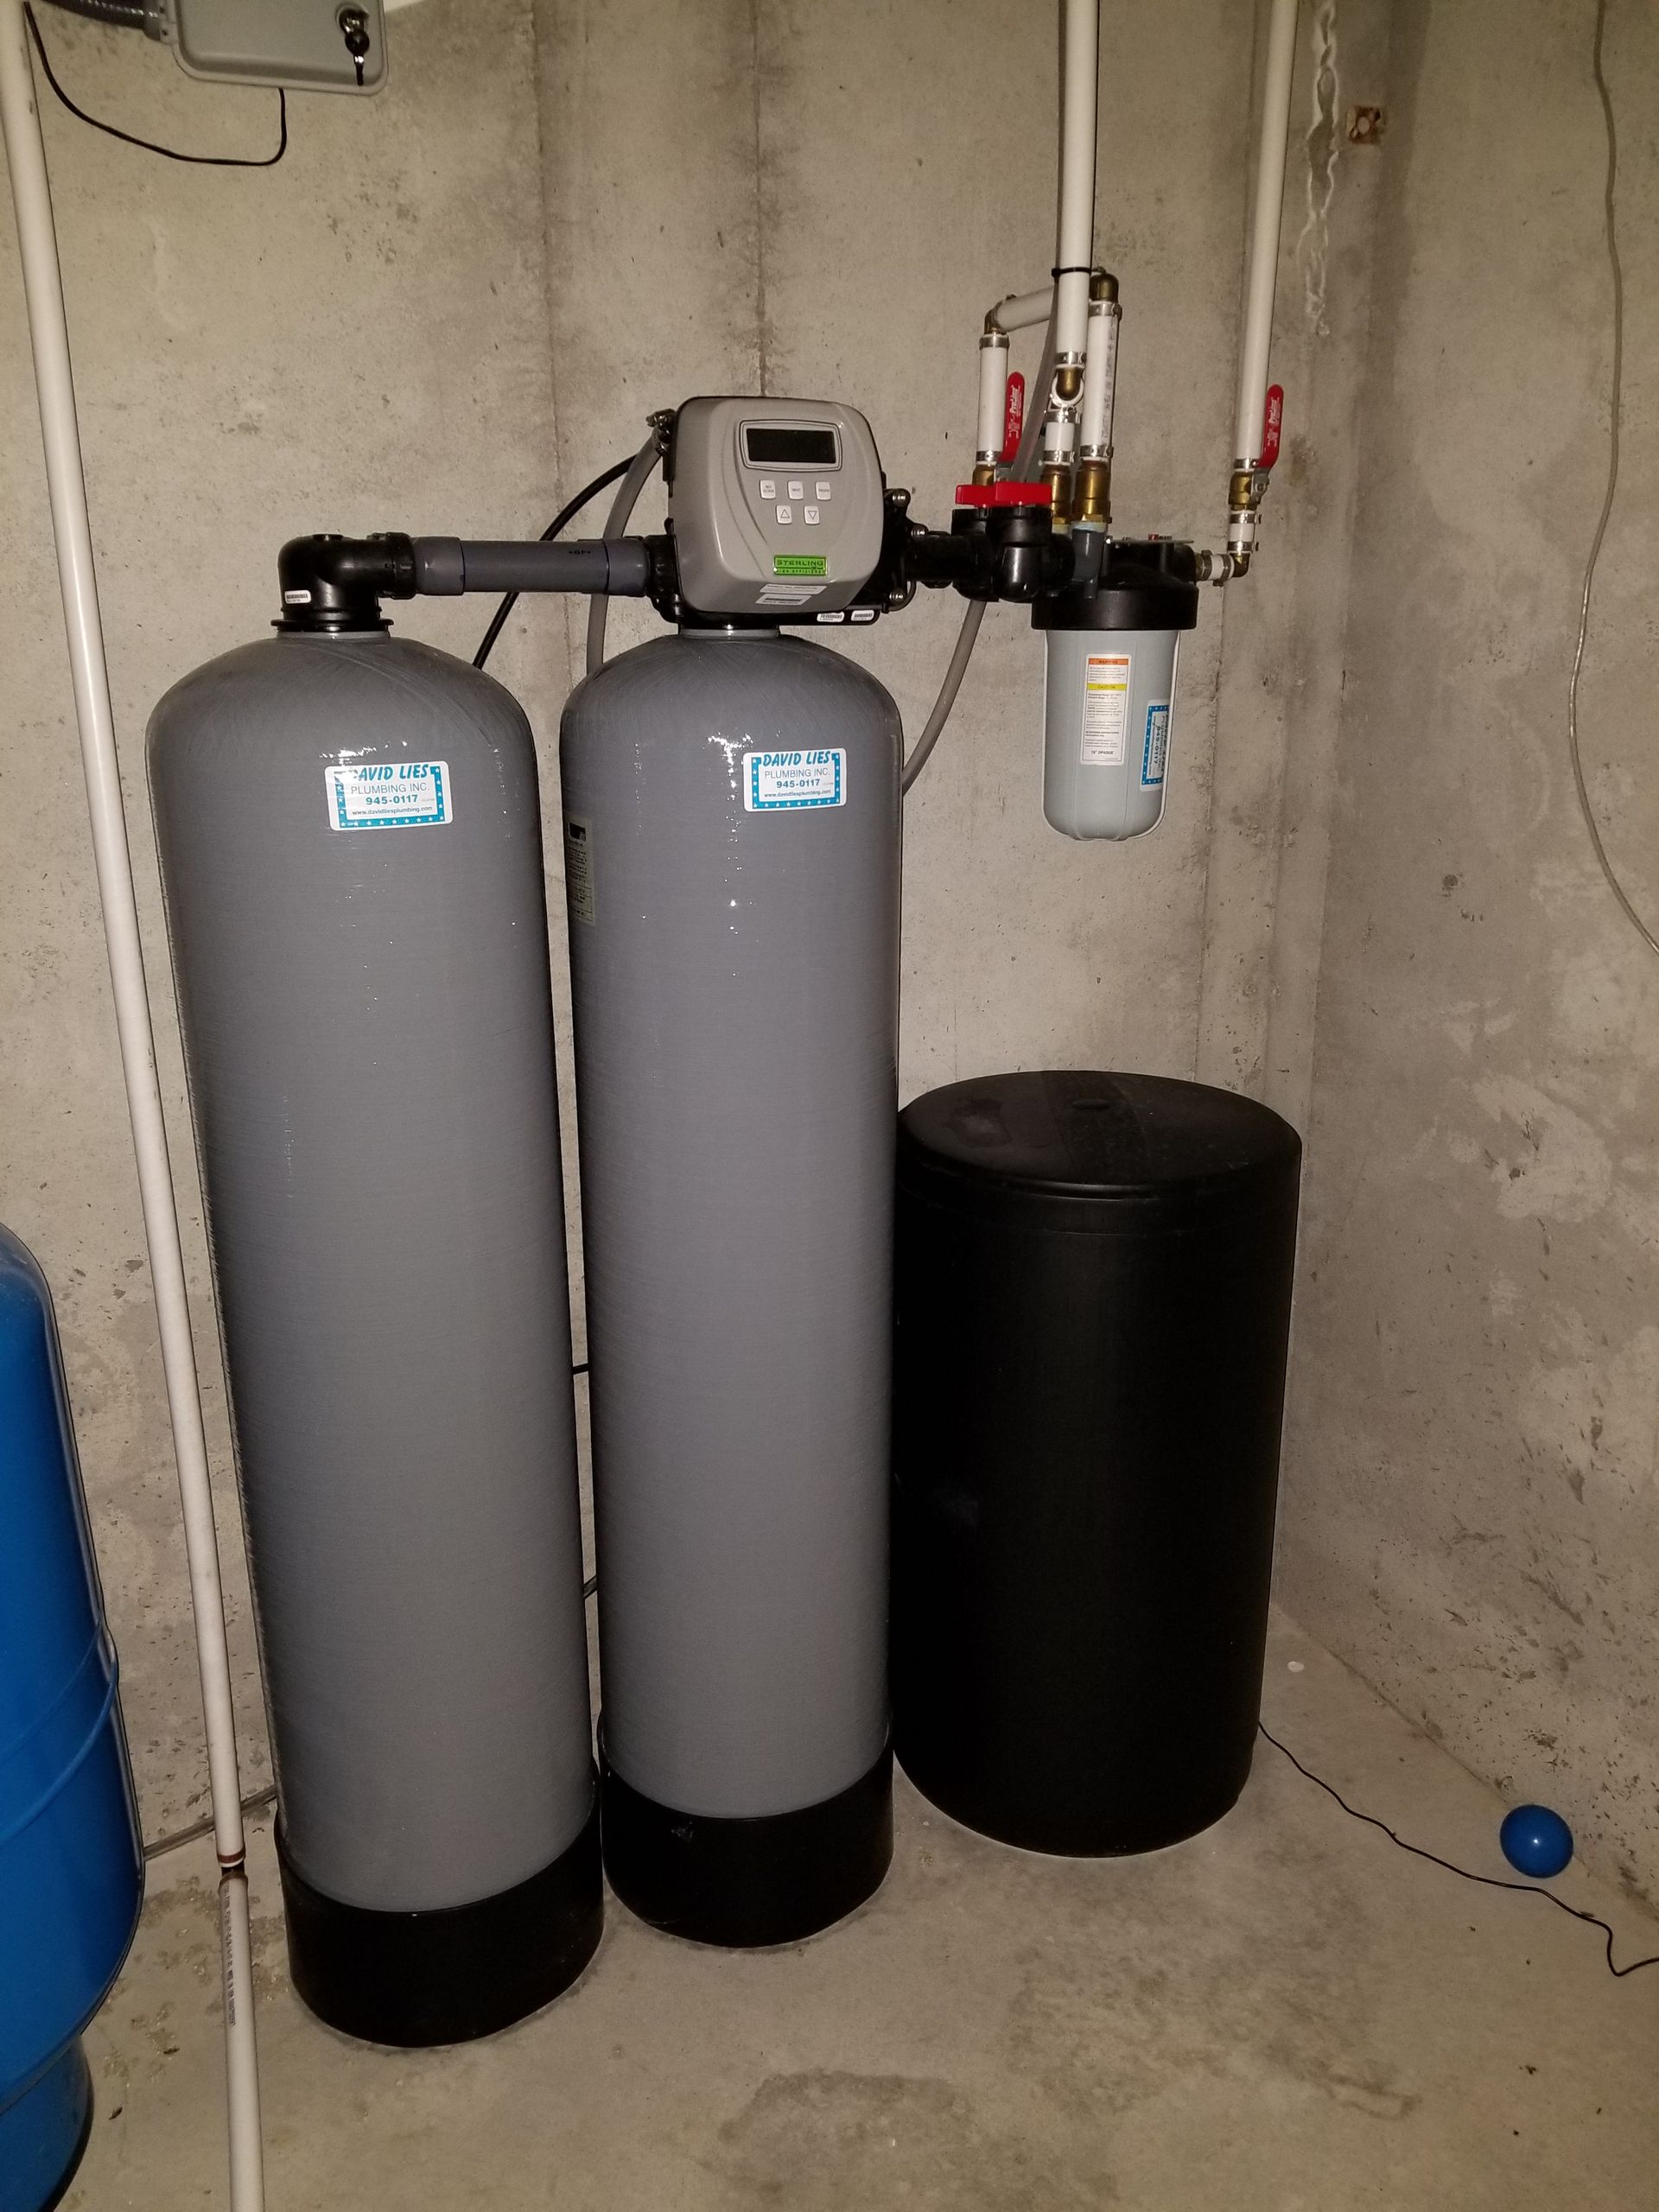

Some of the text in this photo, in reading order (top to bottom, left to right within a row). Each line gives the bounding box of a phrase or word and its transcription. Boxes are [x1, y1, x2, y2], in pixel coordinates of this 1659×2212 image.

[763, 751, 831, 766] DAVID LIES
[353, 763, 429, 781] AVID LIES
[765, 767, 830, 779] PLUMBING INC.
[351, 782, 430, 795] PLUMBING INC.
[776, 779, 820, 789] 945-0117
[365, 794, 418, 805] 945-0117
[352, 806, 433, 816] www.davidliesplumbing.com
